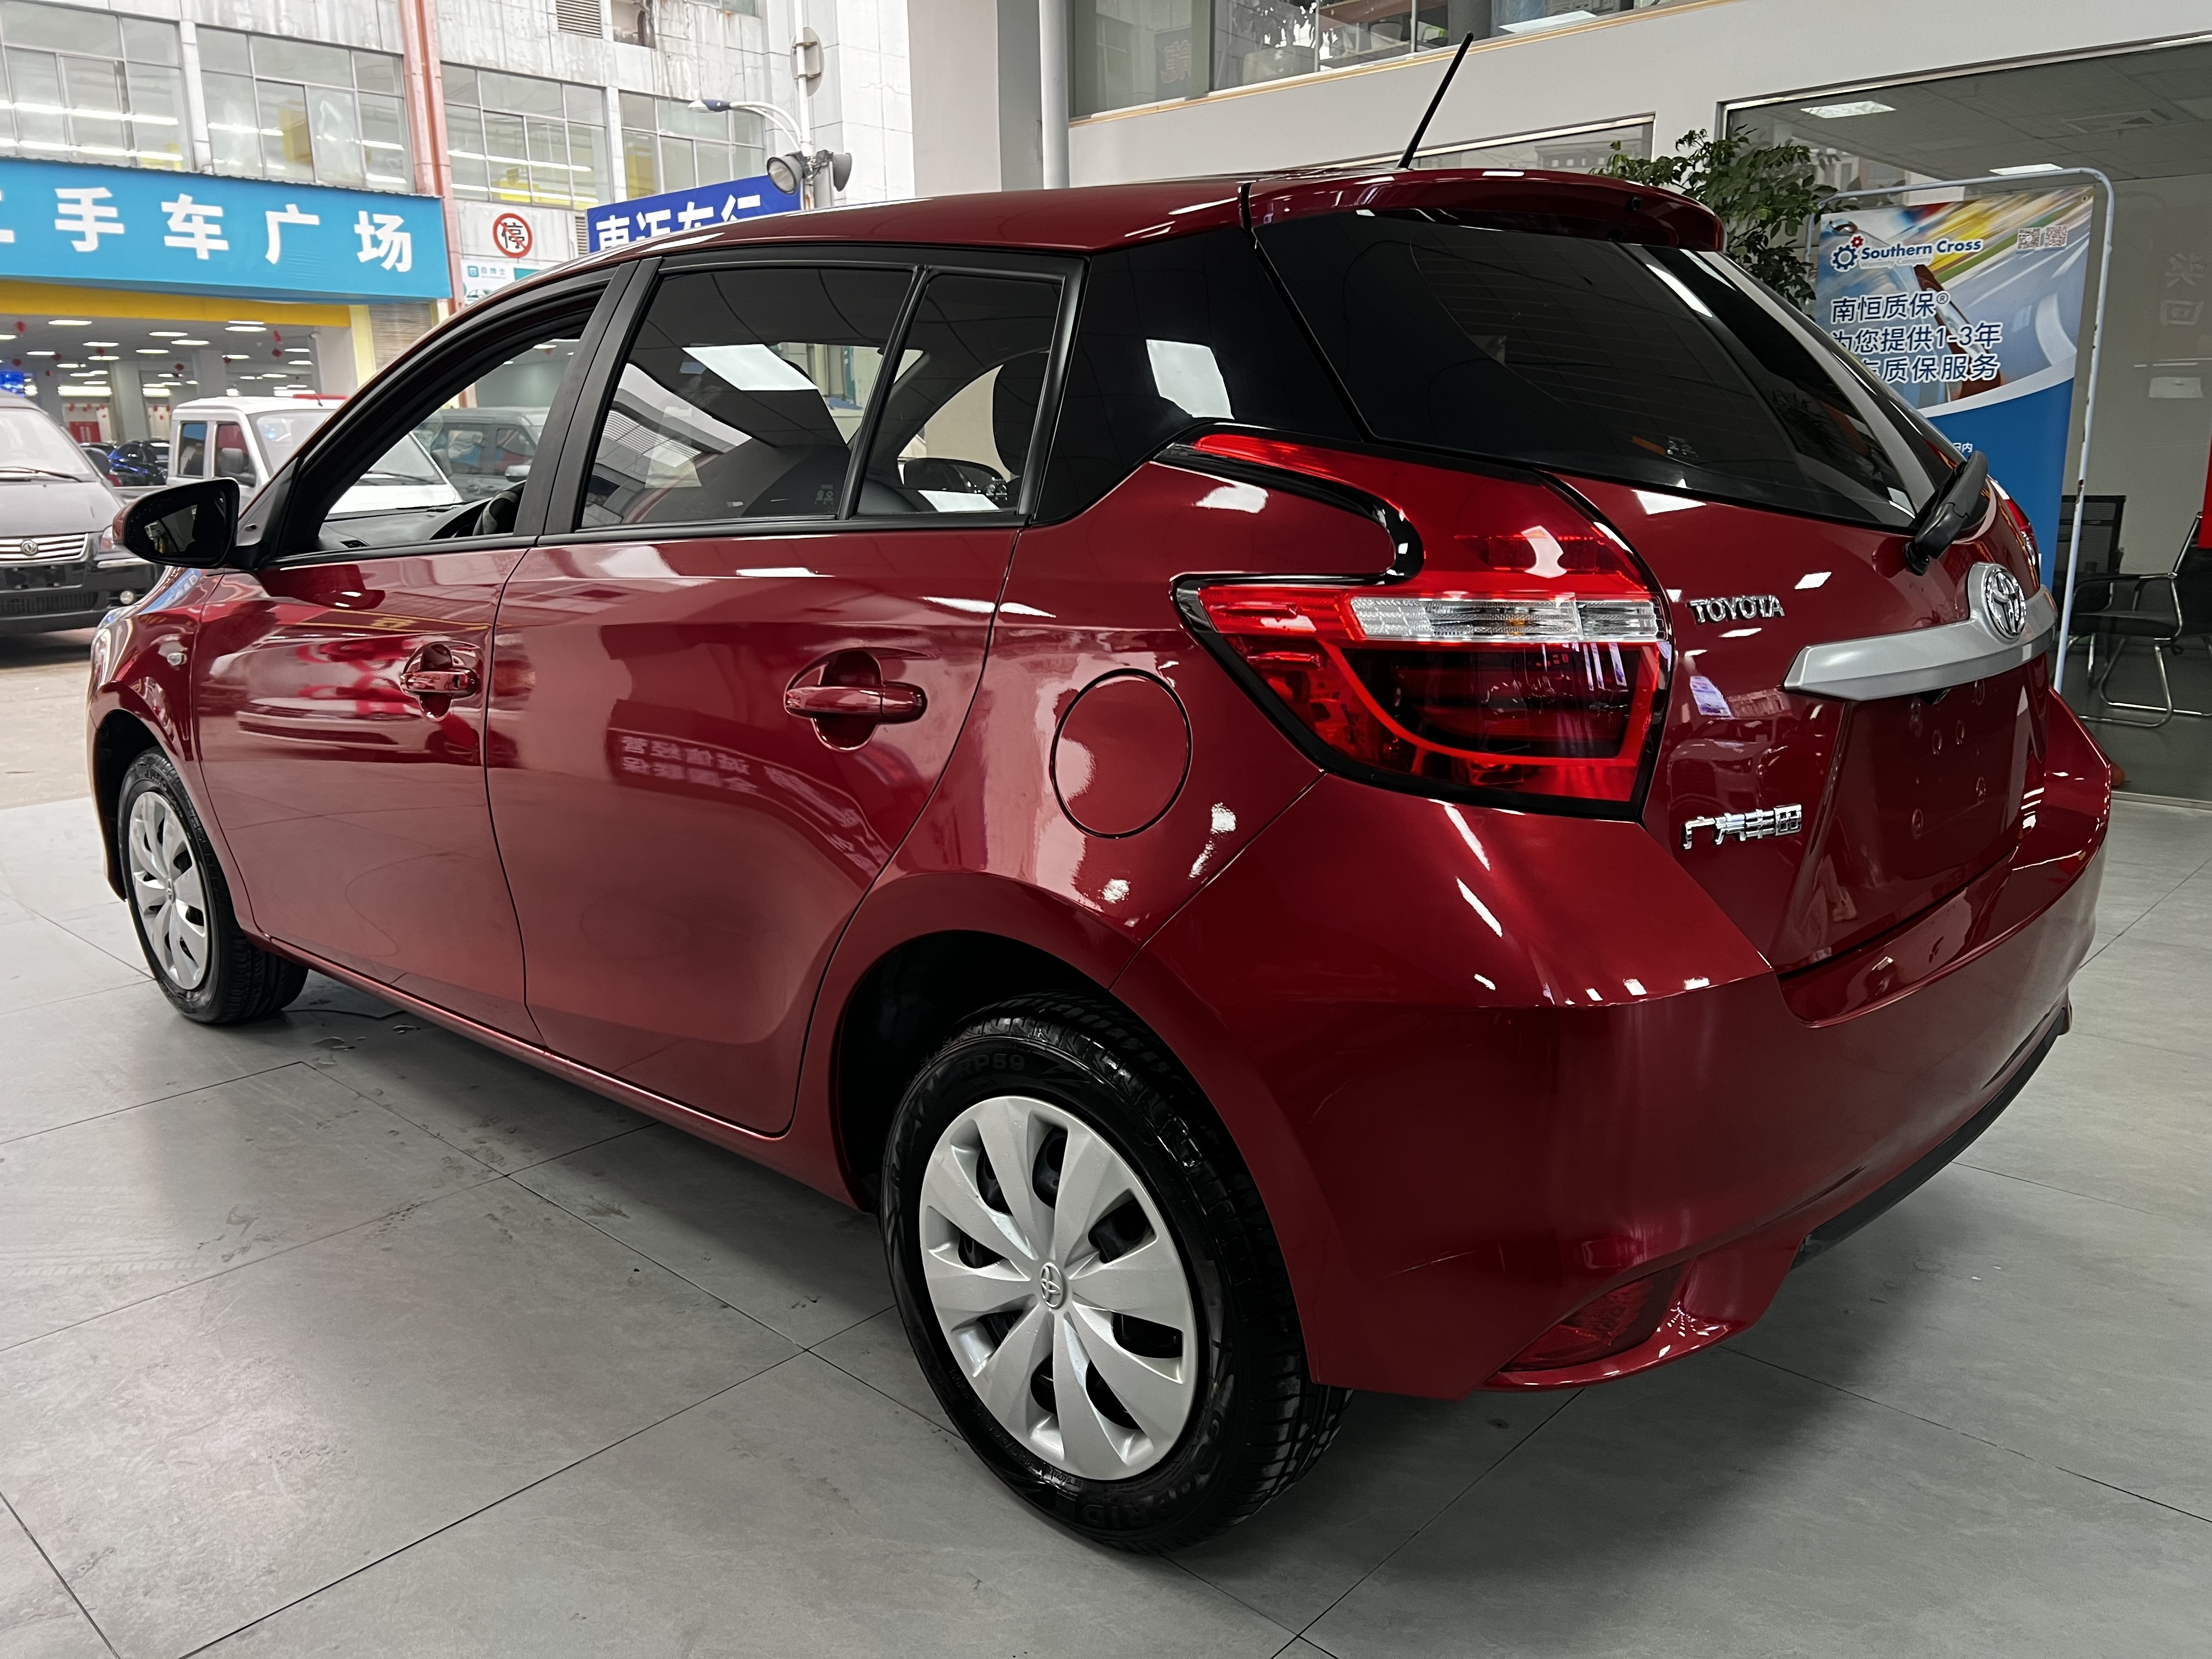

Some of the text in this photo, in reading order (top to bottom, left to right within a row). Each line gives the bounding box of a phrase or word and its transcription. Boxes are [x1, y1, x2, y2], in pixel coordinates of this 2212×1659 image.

[0, 187, 413, 272] 手车广场
[501, 222, 525, 249] 停
[1861, 240, 1982, 260] Southern Cross
[1832, 321, 2002, 353] 为您提供1-3年
[1689, 595, 1786, 624] TOYOTA
[1683, 804, 1802, 850] 广汽丰田
